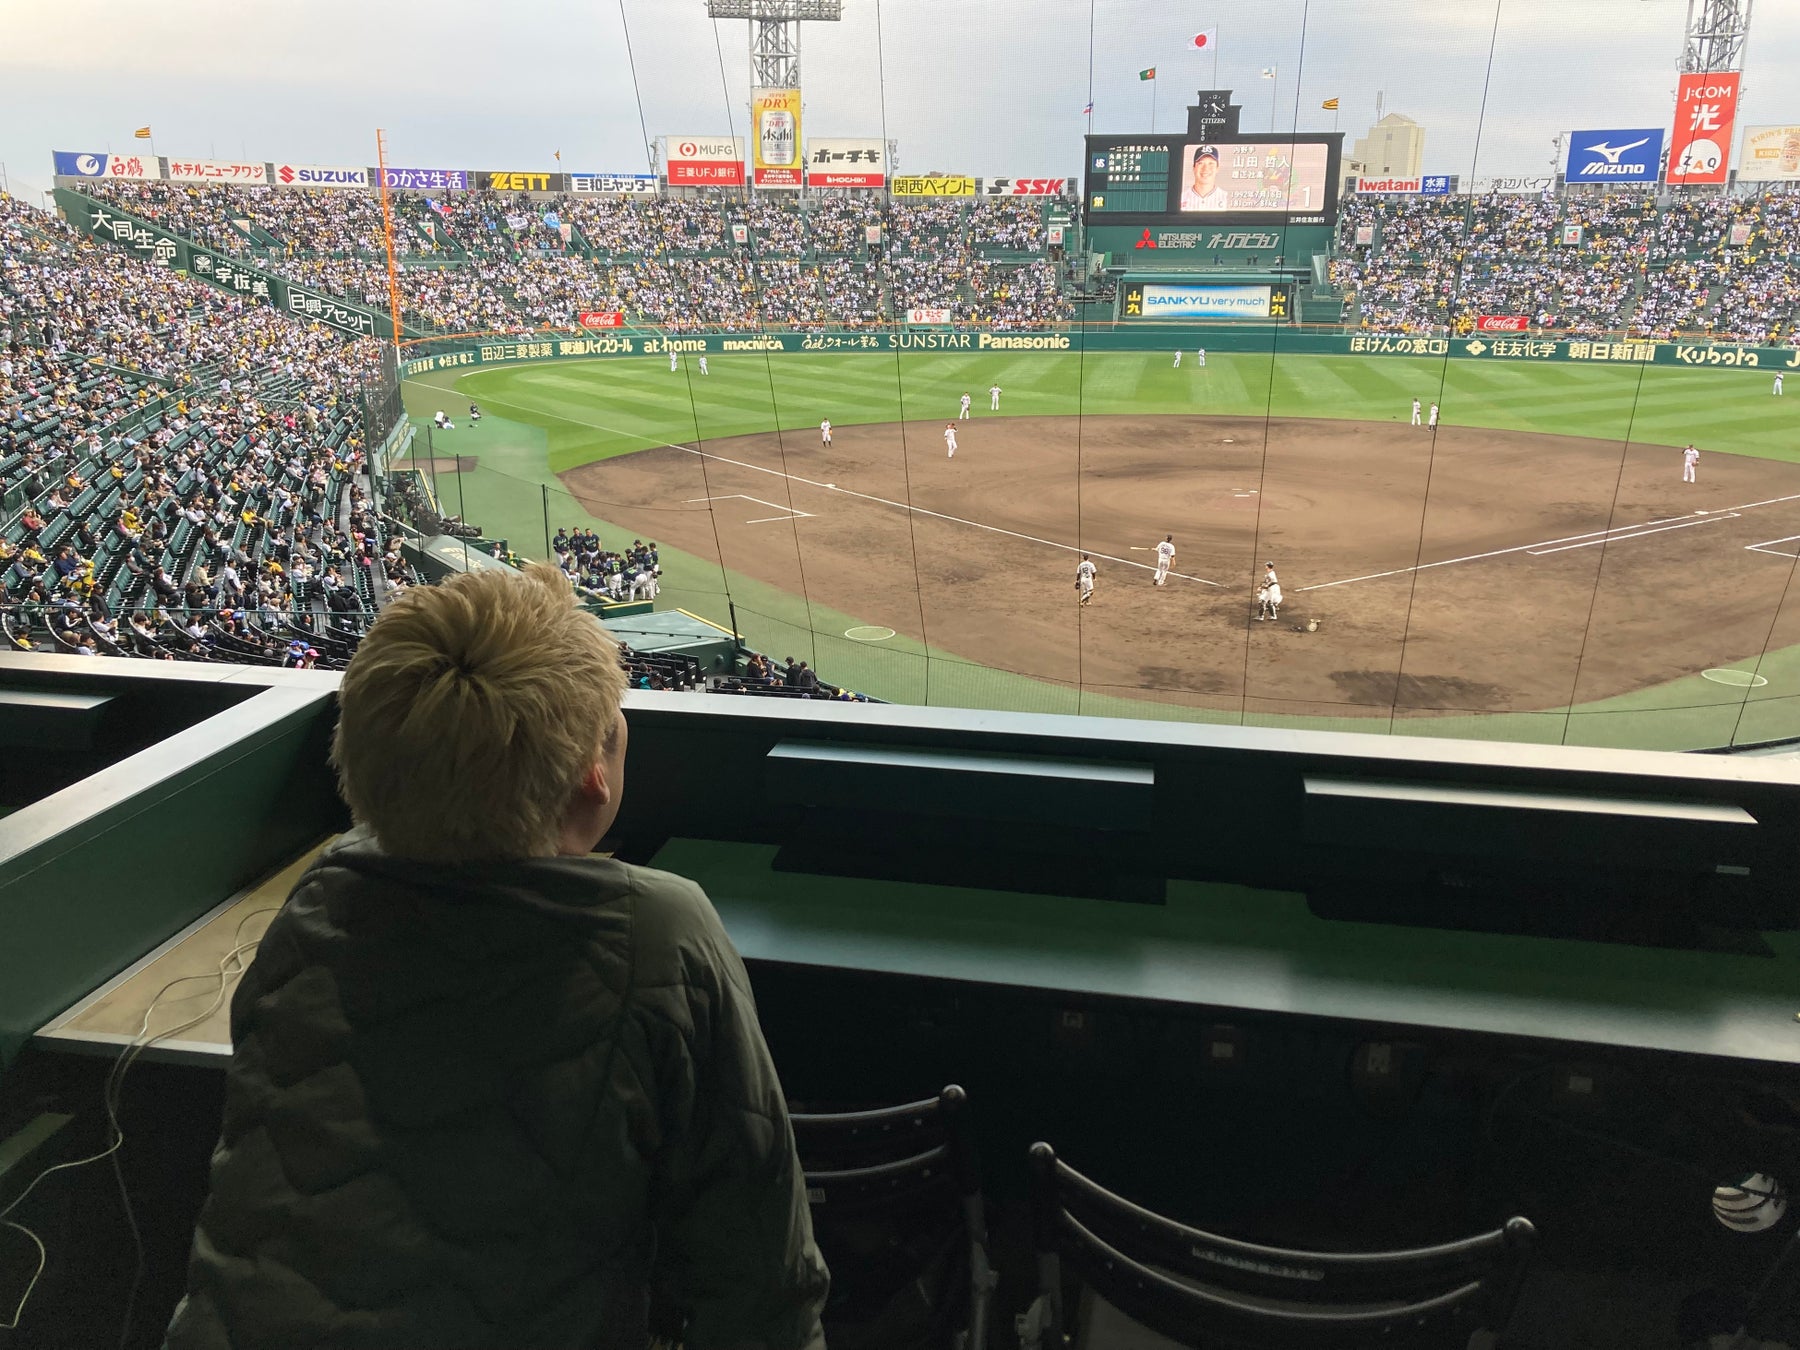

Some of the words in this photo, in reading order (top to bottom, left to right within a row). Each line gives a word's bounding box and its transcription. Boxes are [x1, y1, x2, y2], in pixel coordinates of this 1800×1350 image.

[1684, 86, 1731, 102] J:COM
[1690, 104, 1721, 131] 光
[763, 128, 792, 141] Asahi
[699, 145, 733, 155] MUFG
[813, 149, 880, 163] ホーチキ
[111, 156, 144, 177] 白鶴
[1233, 155, 1258, 168] 山田
[171, 162, 264, 179] ホテルニューアワジ
[299, 169, 365, 184] SUZUKI
[677, 167, 737, 178] 三菱UFJ銀行
[384, 169, 463, 189] わかさ生活
[489, 173, 551, 190] ZETT
[577, 178, 653, 192] 三和シャッター
[893, 179, 974, 195] 関西ペイント
[1013, 179, 1066, 195] SSK
[1359, 178, 1419, 192] Iwatani
[1425, 177, 1447, 188] 水素
[1491, 177, 1555, 190] 渡辺パイプ
[1302, 185, 1311, 207] 1
[91, 209, 177, 259] 大同生命
[1159, 233, 1202, 241] MITSUBISHI
[215, 267, 269, 298] 宇佐美
[1127, 290, 1141, 314] 山九
[1147, 296, 1210, 305] SANKYU
[1212, 298, 1237, 307] very
[1237, 297, 1265, 306] much
[291, 294, 371, 331] 日興アセット
[559, 338, 633, 355] 東進ハイスクール
[888, 334, 971, 348] SUNSTAR
[979, 333, 1070, 349] Panasonic
[1351, 337, 1448, 354] ほけんの窓口
[1491, 340, 1557, 357] 住友化学
[481, 343, 553, 361] 田辺三菱製薬
[1568, 342, 1656, 361] 朝日新聞
[1676, 345, 1758, 367] Kubota
